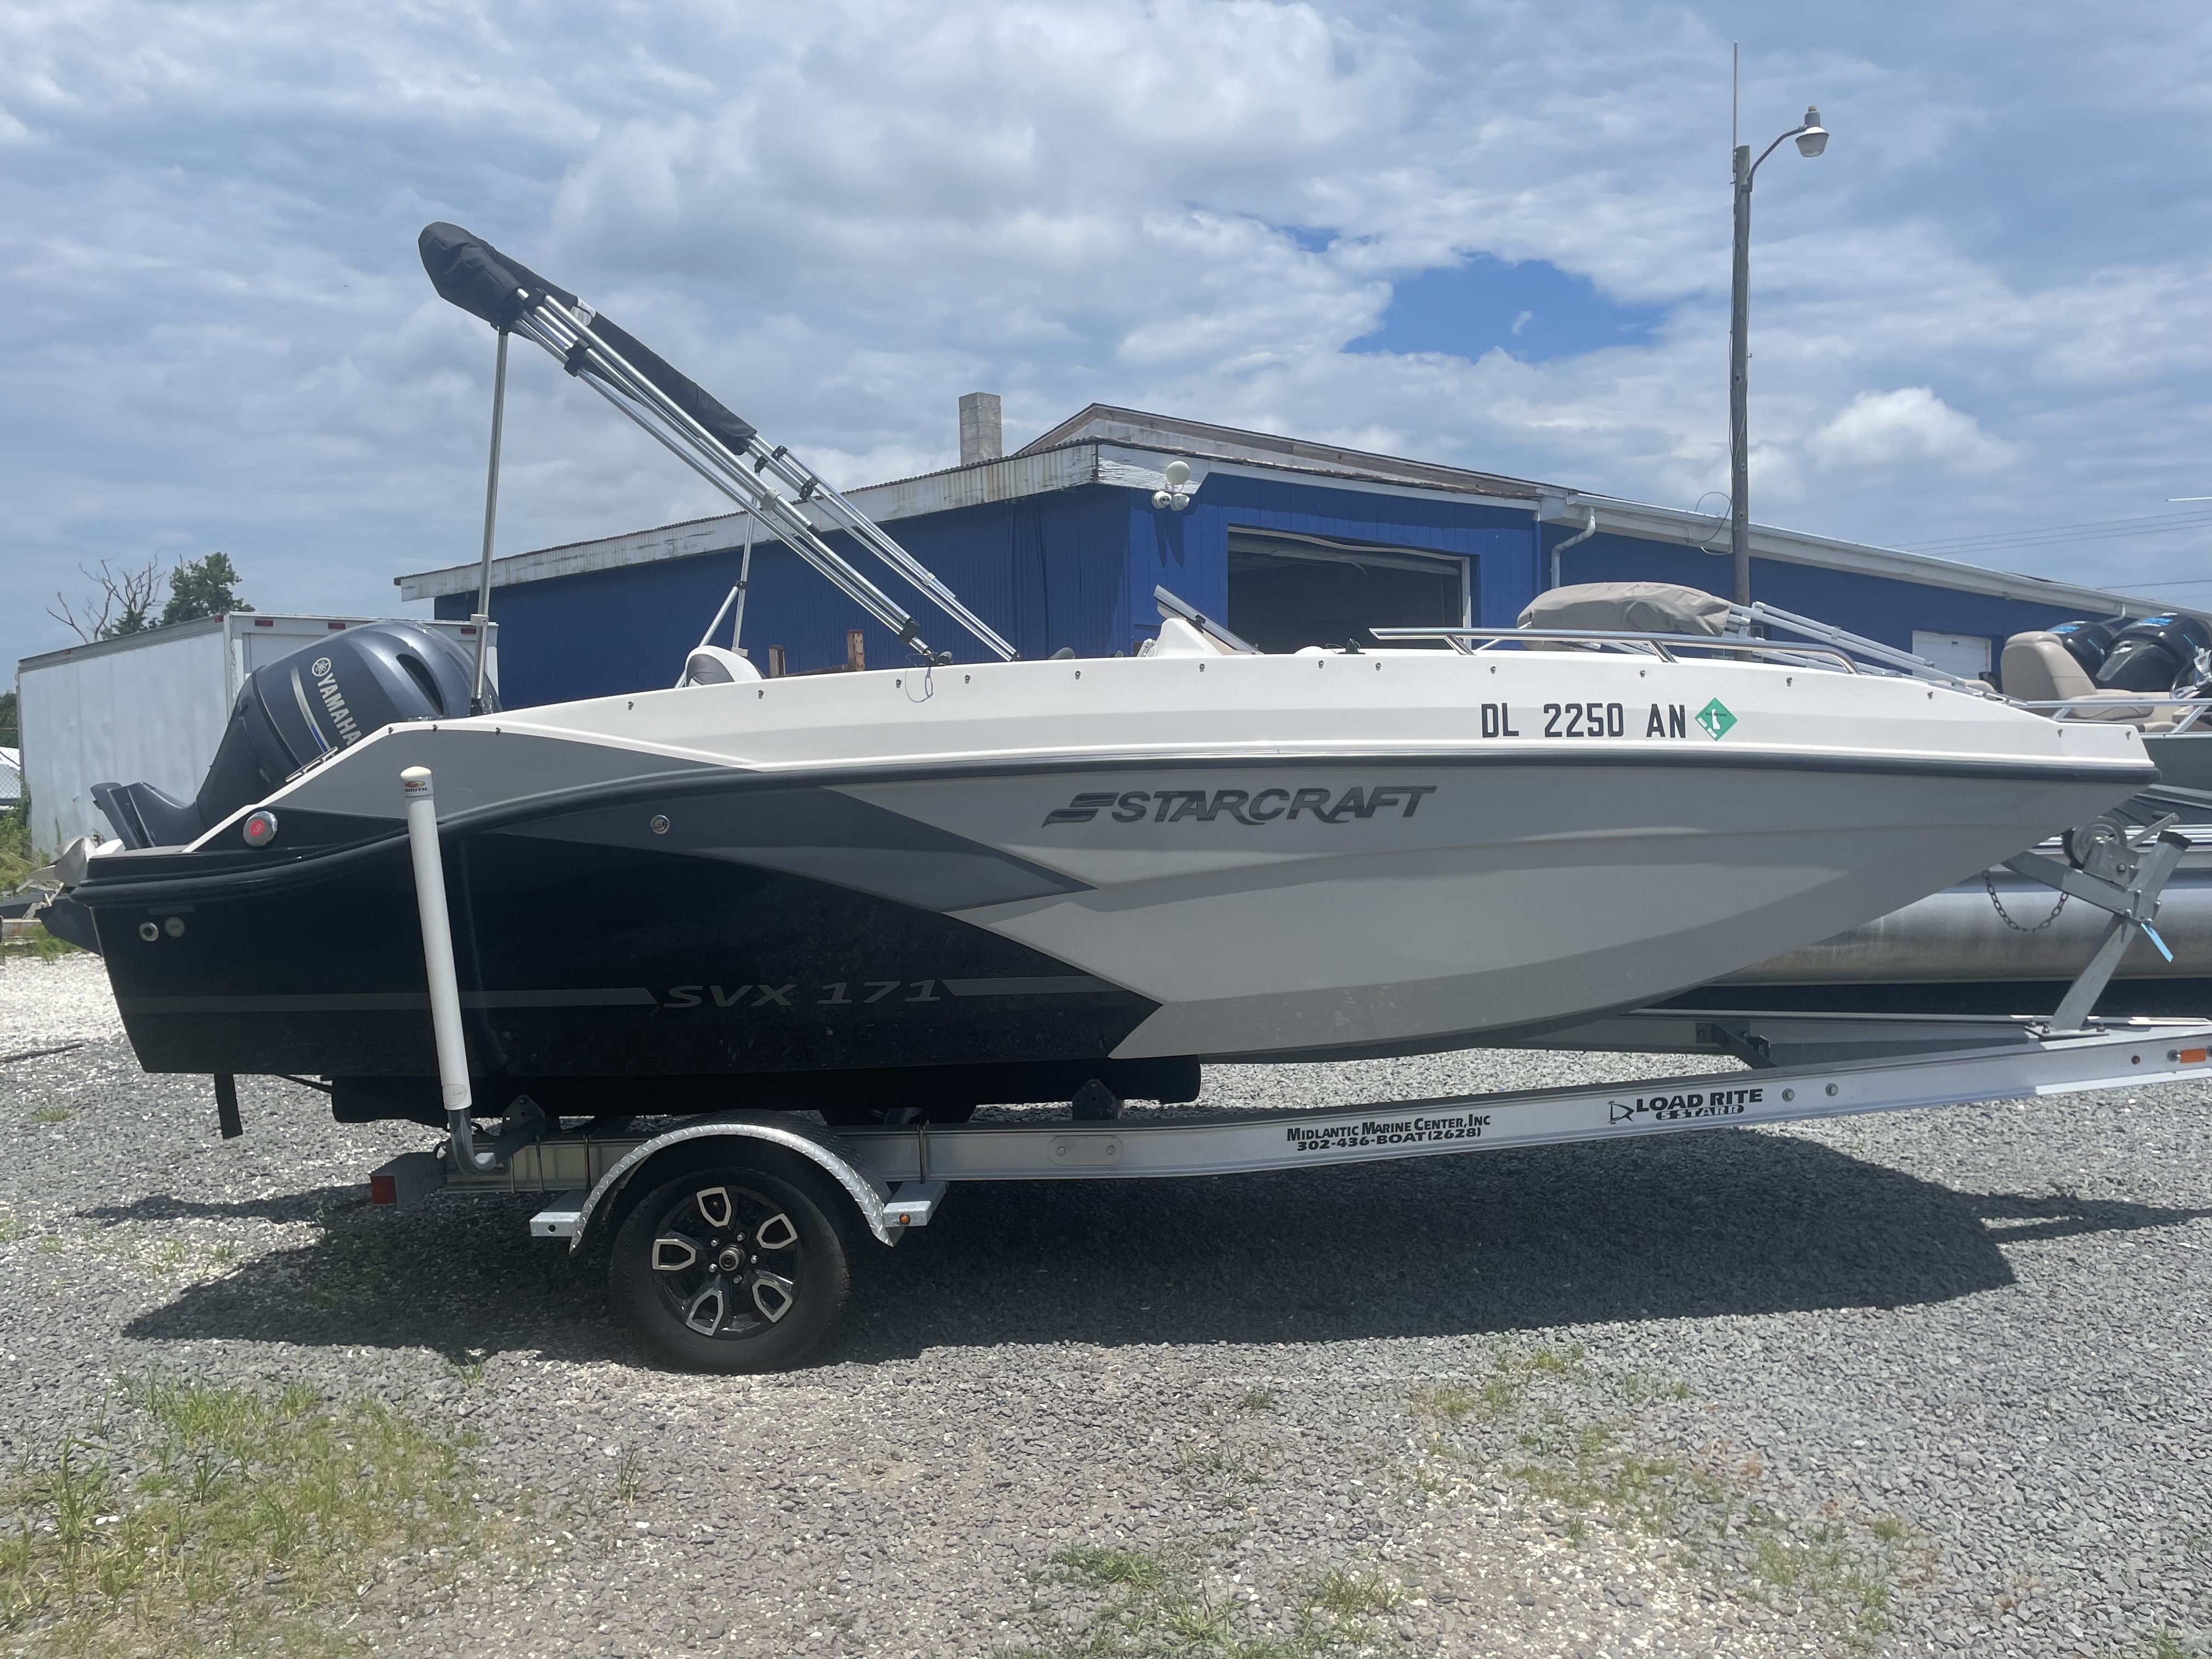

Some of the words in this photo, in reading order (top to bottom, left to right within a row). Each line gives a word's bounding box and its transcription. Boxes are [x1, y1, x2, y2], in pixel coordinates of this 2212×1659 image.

[317, 672, 362, 746] YAMAHA
[1481, 703, 1519, 738] DL
[1543, 703, 1624, 738] 2250
[1646, 703, 1686, 738] AN
[1111, 785, 1437, 826] STARCRAFT
[663, 984, 798, 1008] SVX
[816, 979, 941, 1005] 171
[1636, 1093, 1703, 1113] LOAD
[1710, 1088, 1763, 1107] RITE
[1661, 1110, 1672, 1120] 5
[1677, 1105, 1739, 1119] STARR
[1287, 1125, 1359, 1142] MIDLANTIC
[1362, 1121, 1412, 1136] MARINE
